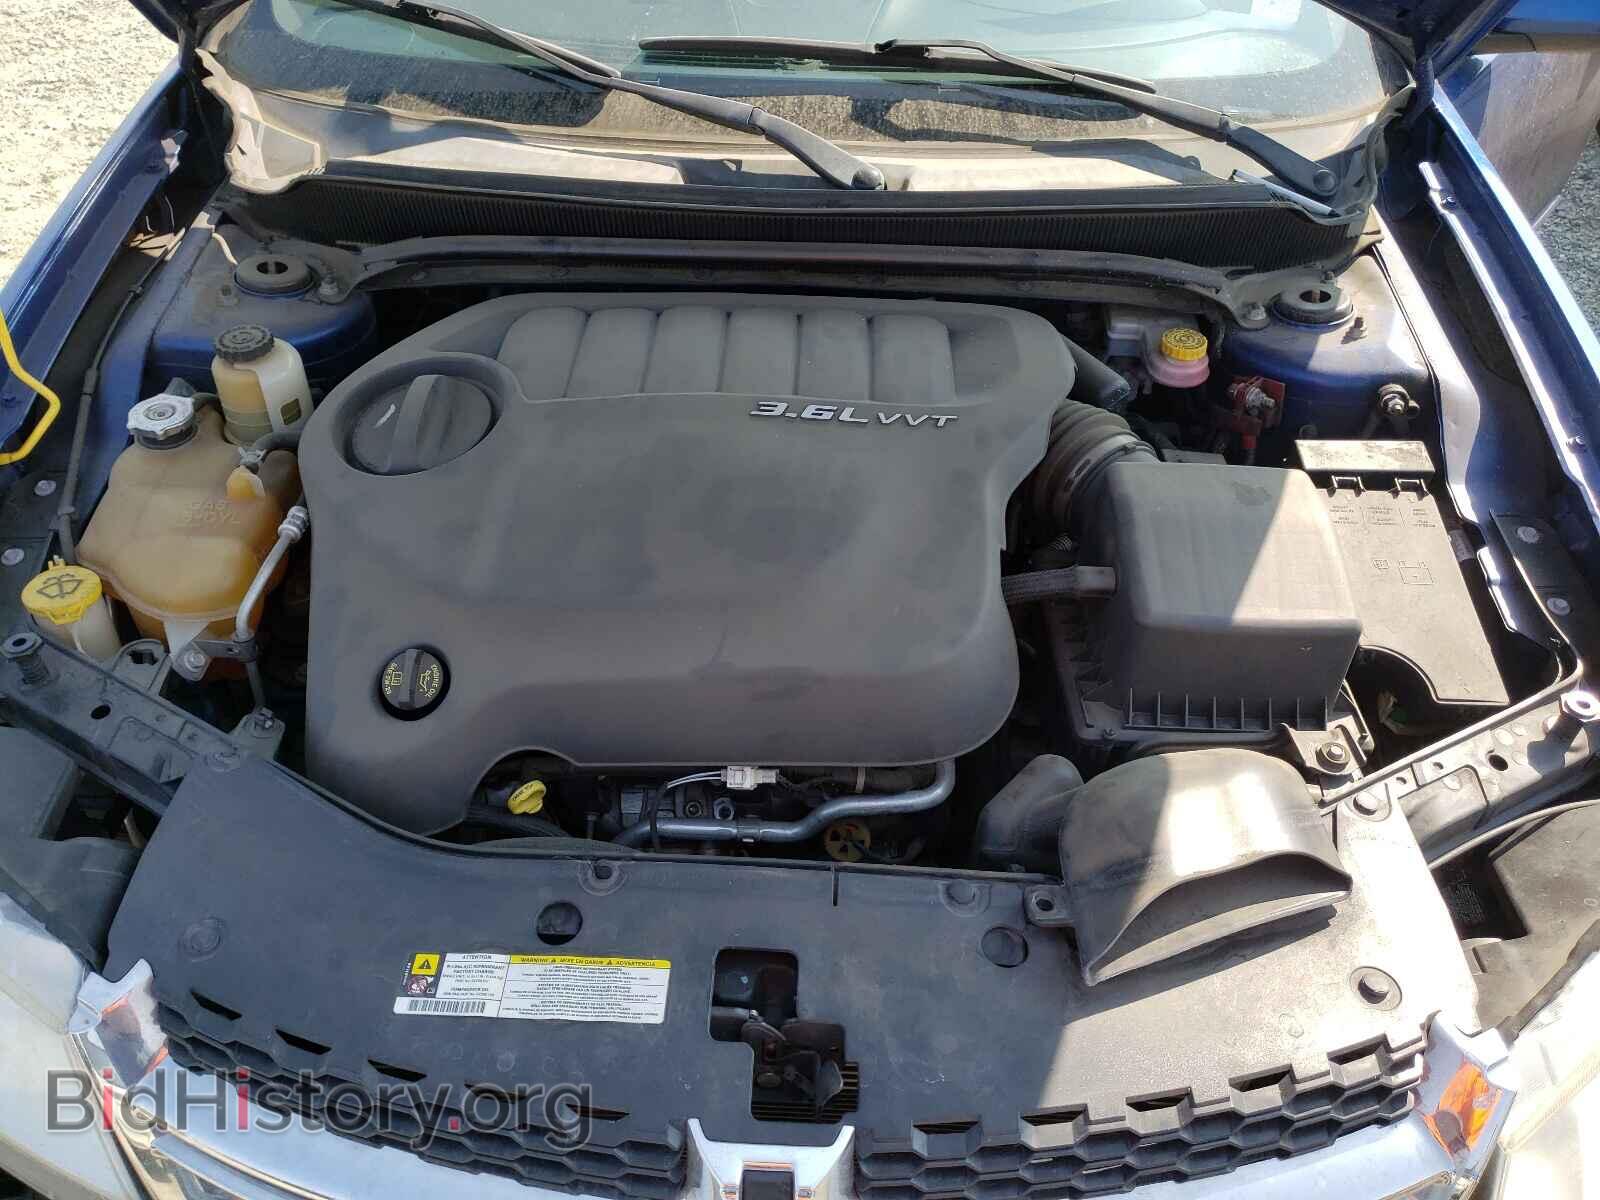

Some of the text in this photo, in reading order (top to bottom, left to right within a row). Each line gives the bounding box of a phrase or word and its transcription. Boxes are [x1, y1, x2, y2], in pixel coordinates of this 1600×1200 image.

[750, 401, 959, 428] 3.6L VVT
[425, 688, 436, 698] OIL
